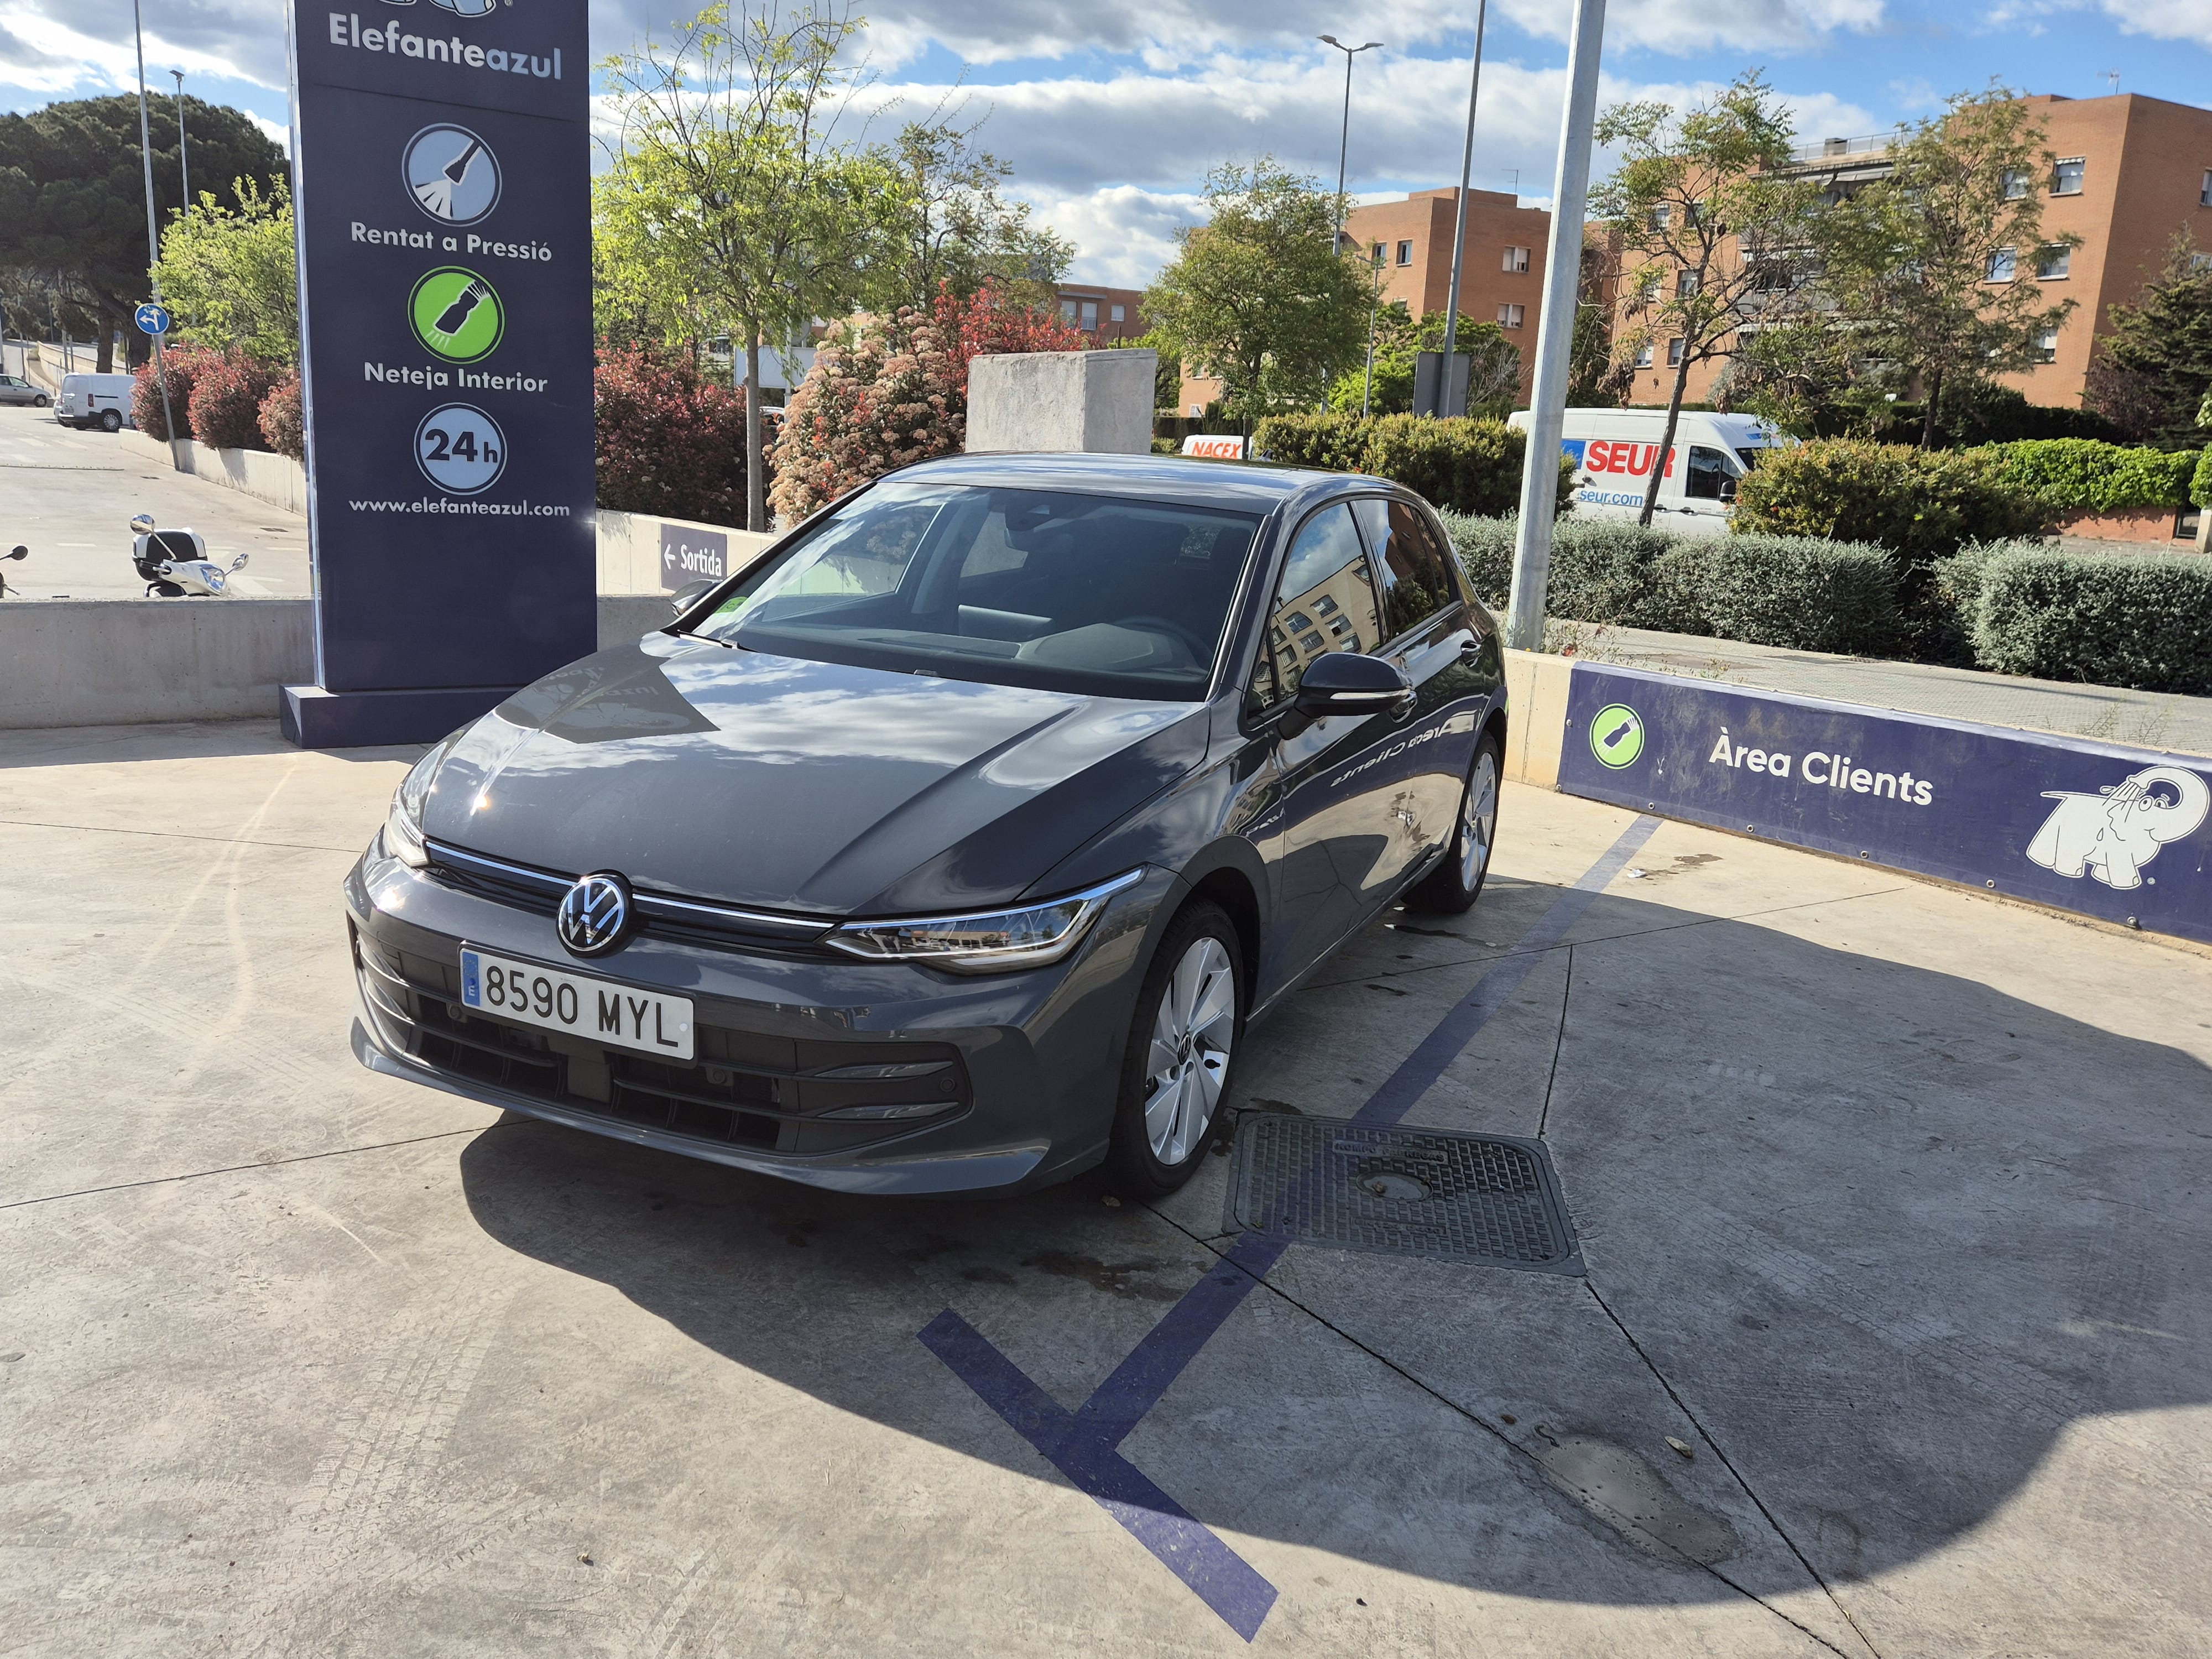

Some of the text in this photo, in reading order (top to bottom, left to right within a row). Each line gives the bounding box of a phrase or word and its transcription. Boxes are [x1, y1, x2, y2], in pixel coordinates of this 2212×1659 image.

[329, 12, 561, 80] Elefanteazul
[351, 221, 552, 261] Rentat a Pressió
[364, 362, 548, 392] Neteja Interior
[1192, 442, 1241, 458] NACEX
[349, 497, 570, 517] www.elefanteazul.com
[1579, 490, 1643, 505] seur.com
[681, 544, 722, 576] Sortida
[1708, 726, 1933, 806] Àrea Clients
[487, 966, 679, 1047] 8590 MYL
